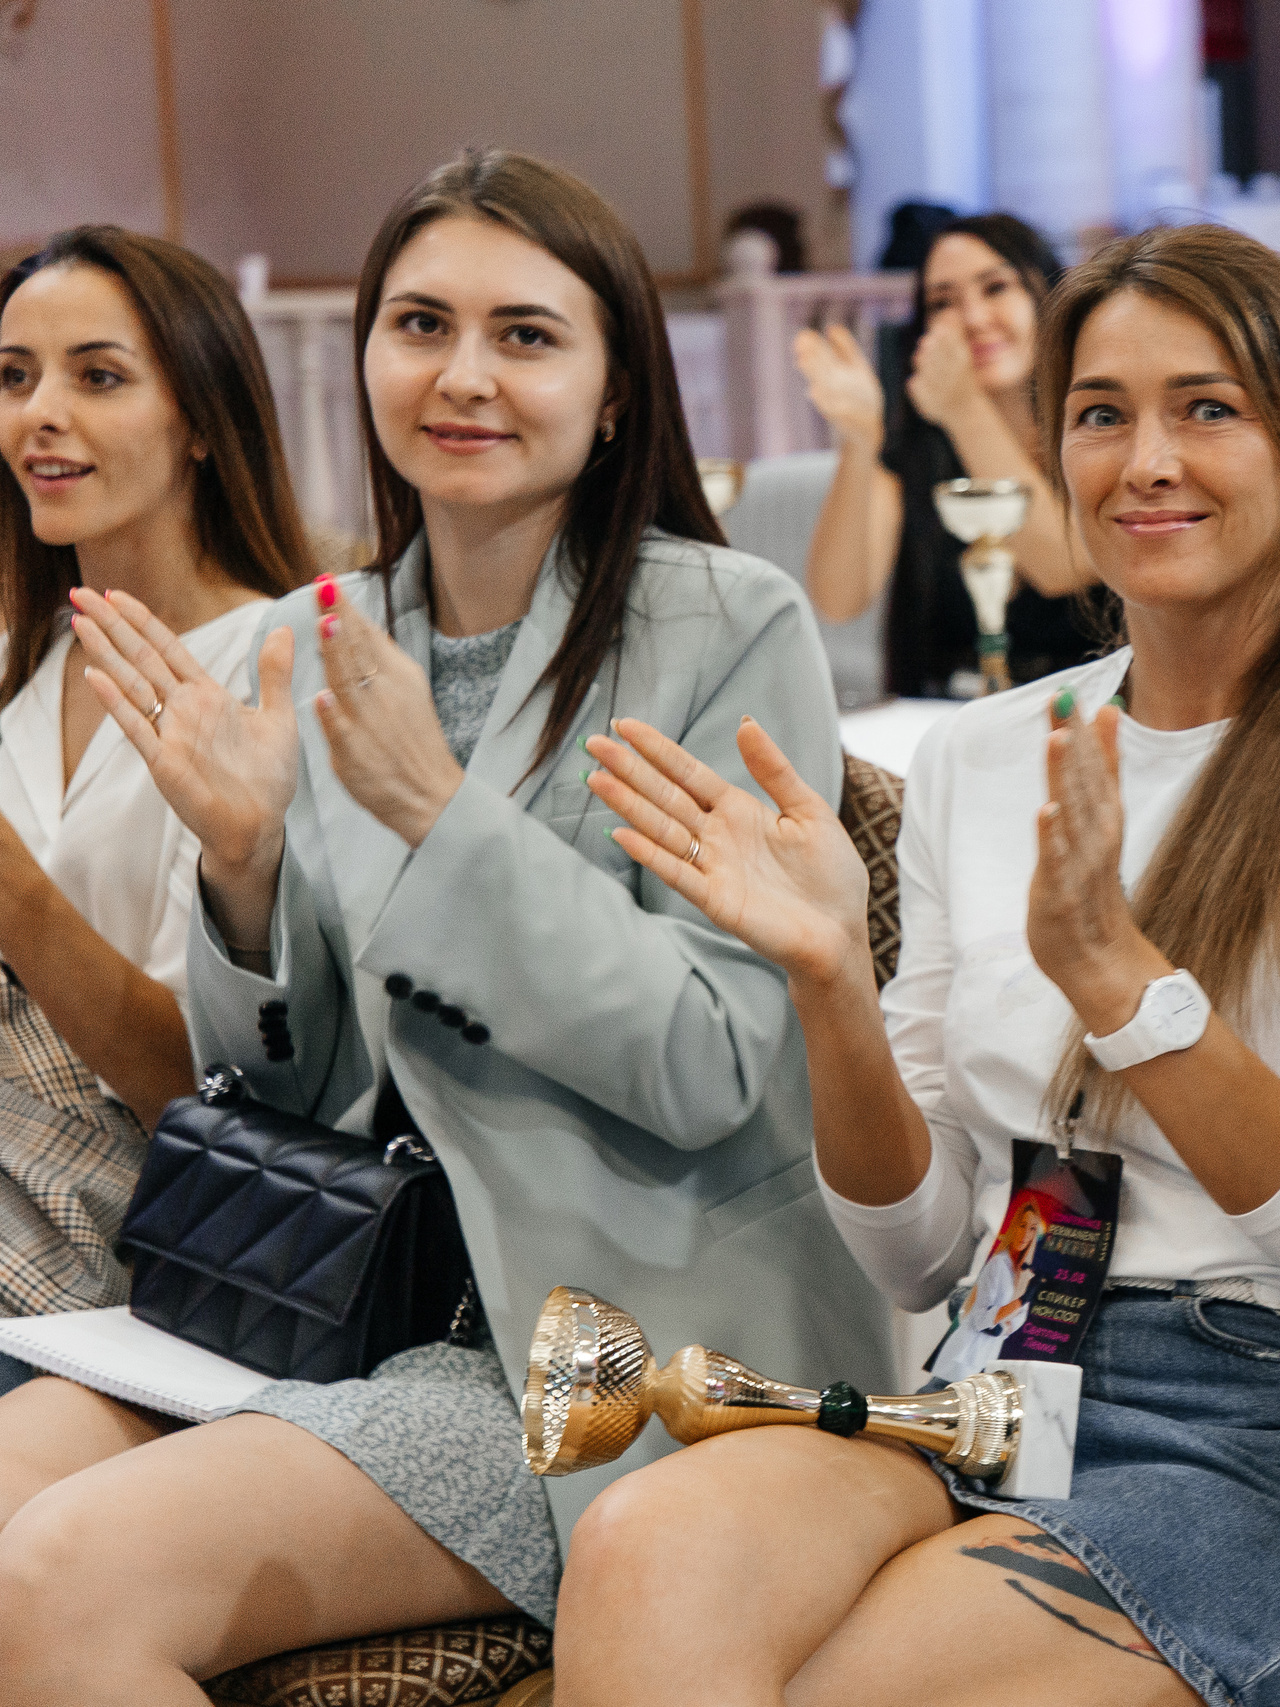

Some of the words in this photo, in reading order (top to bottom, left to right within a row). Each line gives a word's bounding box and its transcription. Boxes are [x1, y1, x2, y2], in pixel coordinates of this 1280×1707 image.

[1049, 1224, 1101, 1242] PERMANENT
[1054, 1268, 1087, 1284] 25.08
[1037, 1290, 1087, 1309] СПИКЕР
